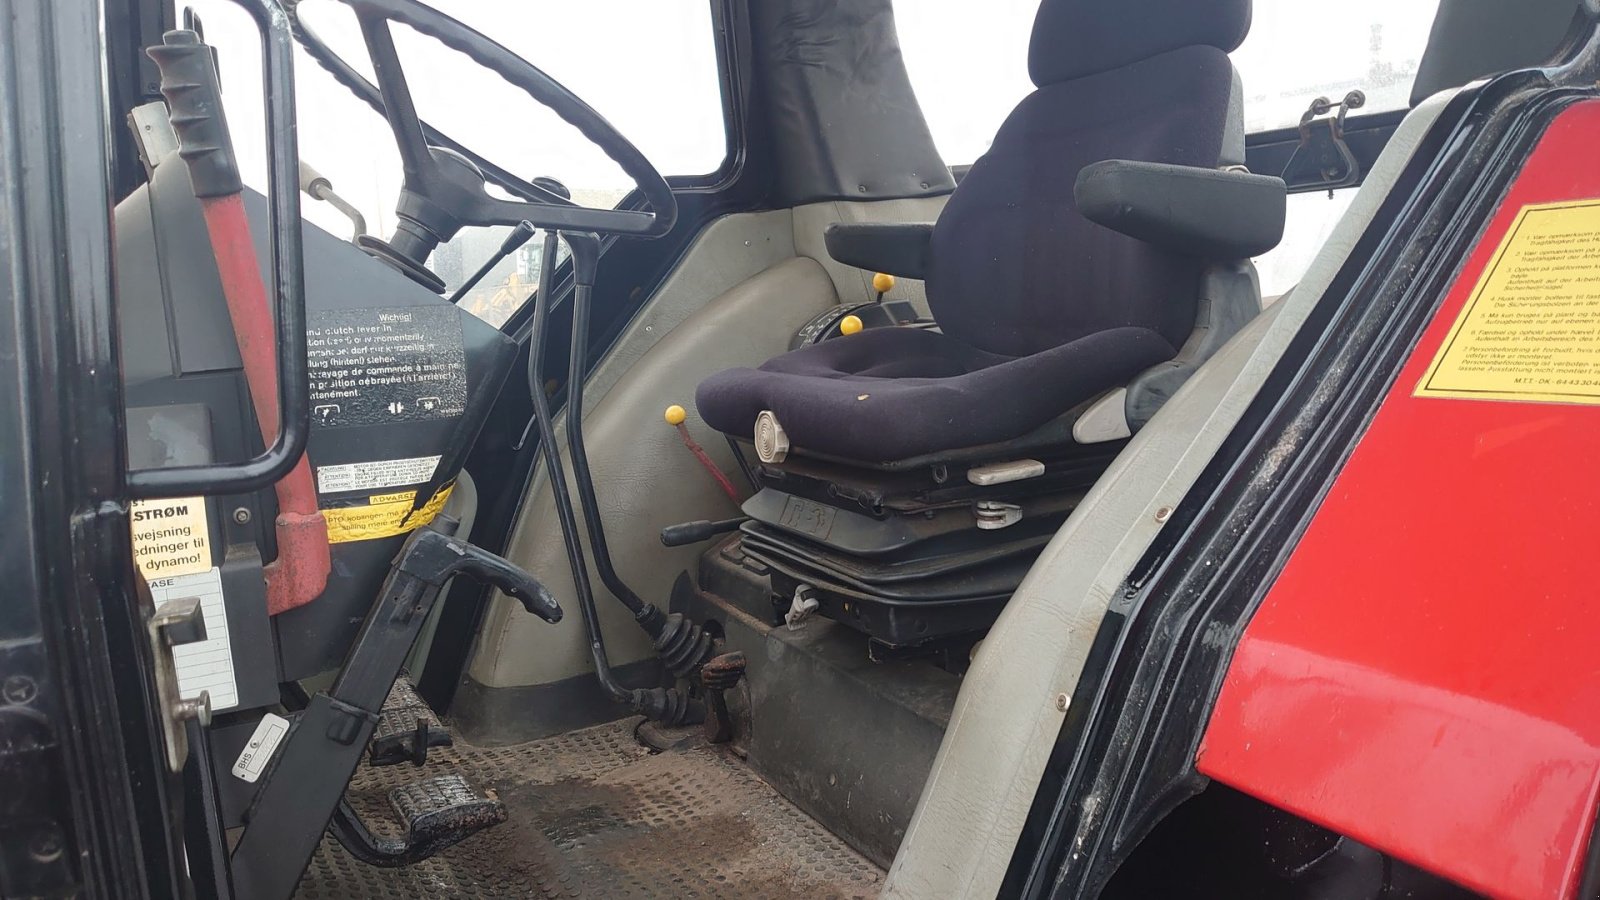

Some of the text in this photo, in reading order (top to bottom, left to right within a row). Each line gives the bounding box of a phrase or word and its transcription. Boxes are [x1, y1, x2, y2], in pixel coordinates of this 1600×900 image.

[134, 505, 189, 522] STRØM
[192, 537, 205, 548] til
[146, 553, 201, 571] dynamo!
[237, 752, 252, 770] BHS
